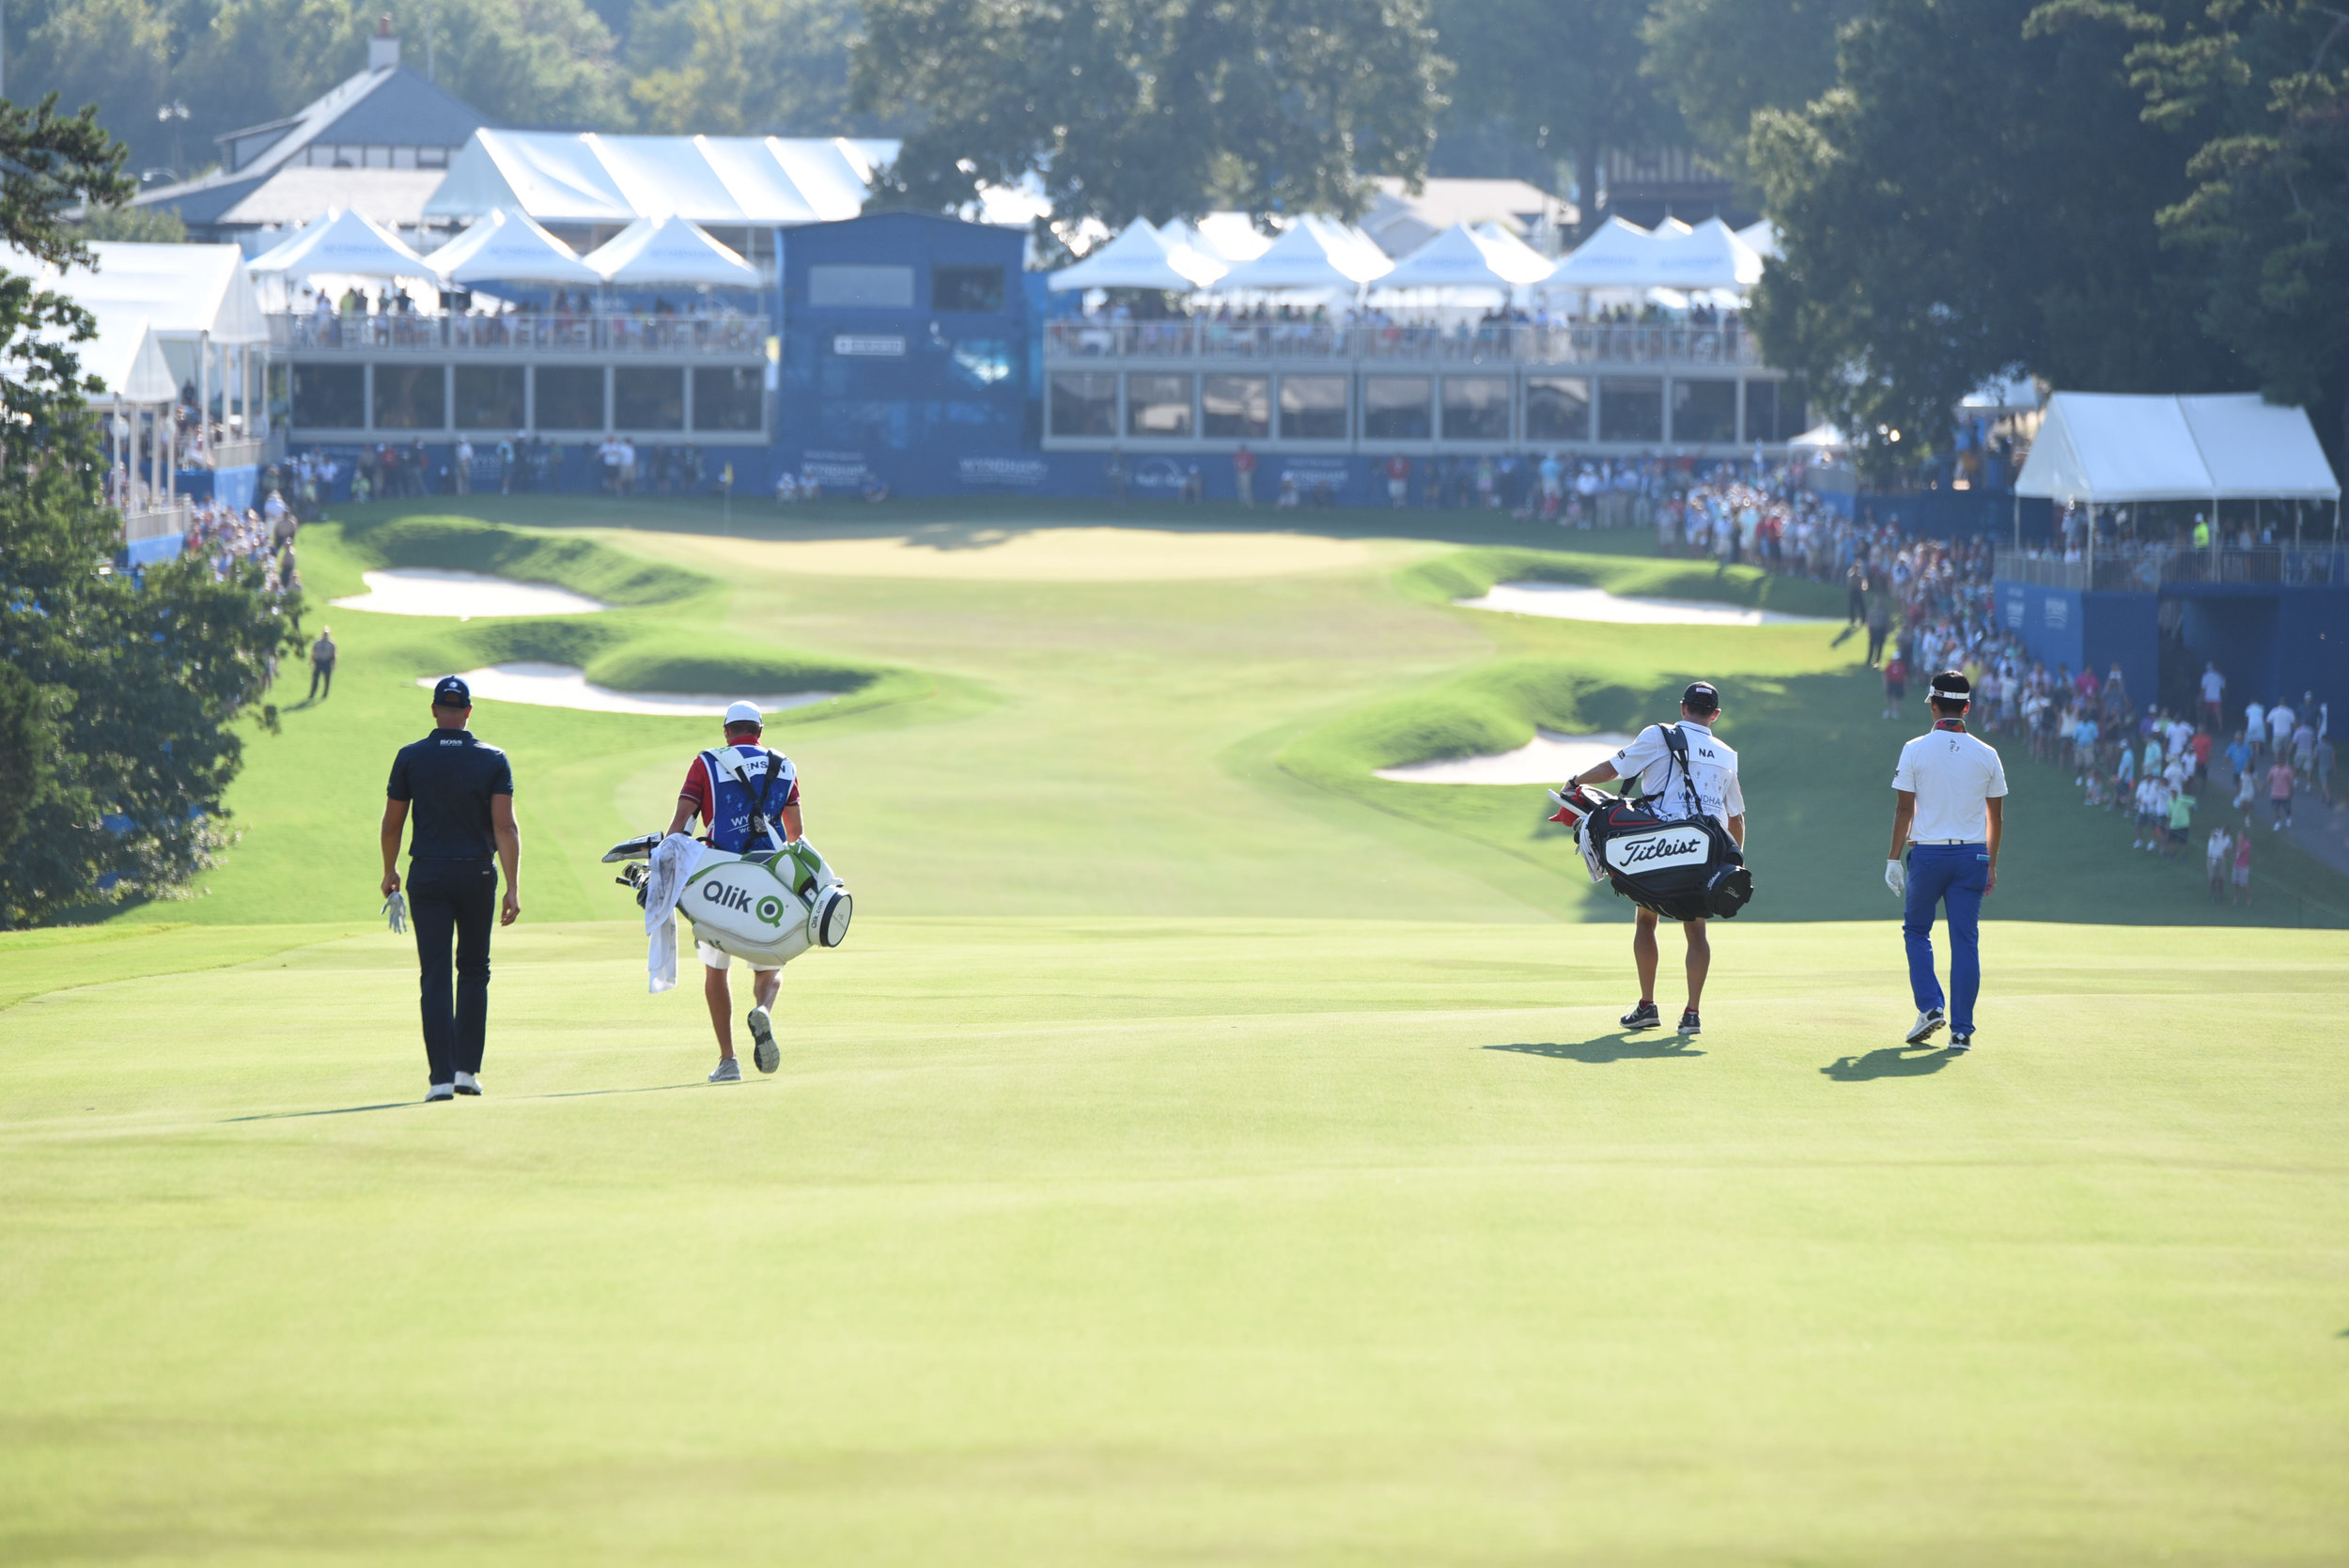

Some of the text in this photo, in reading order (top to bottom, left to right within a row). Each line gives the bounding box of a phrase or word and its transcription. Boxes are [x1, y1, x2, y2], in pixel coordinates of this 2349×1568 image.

[1699, 748, 1715, 758] NA
[1620, 837, 1701, 866] Titleist
[702, 880, 754, 913] Qlik
[811, 900, 824, 929] Qlik.com
